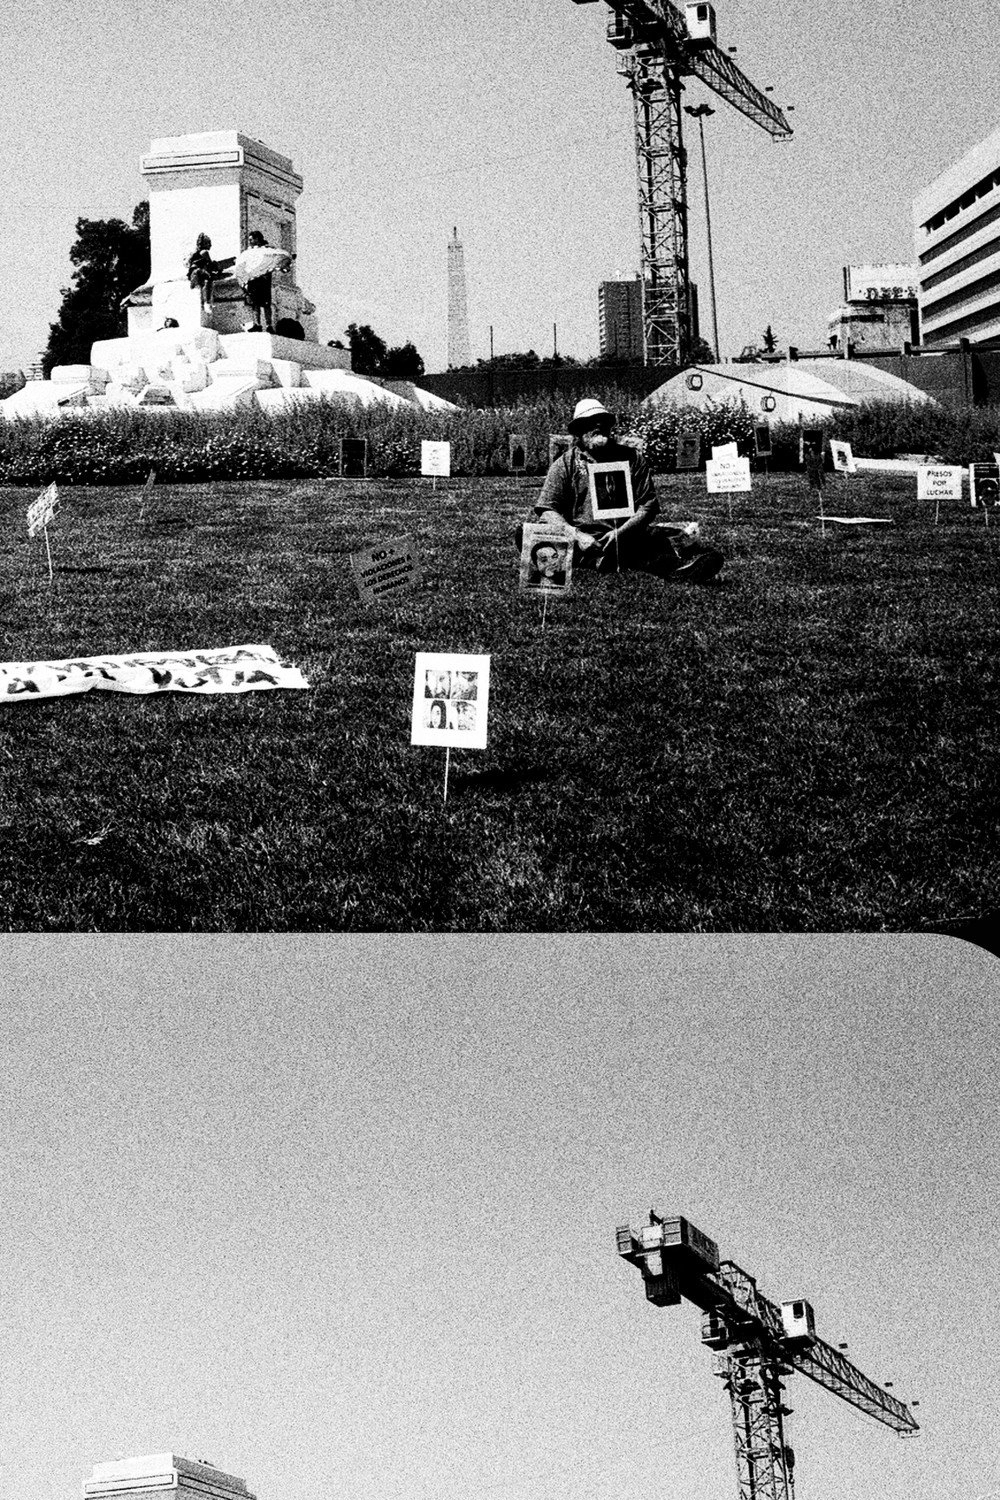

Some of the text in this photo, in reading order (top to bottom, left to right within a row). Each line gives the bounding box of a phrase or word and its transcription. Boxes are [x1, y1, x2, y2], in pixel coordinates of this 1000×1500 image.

[371, 550, 387, 562] NO
[360, 556, 406, 578] VIOLACIONES
[364, 577, 378, 588] LOS
